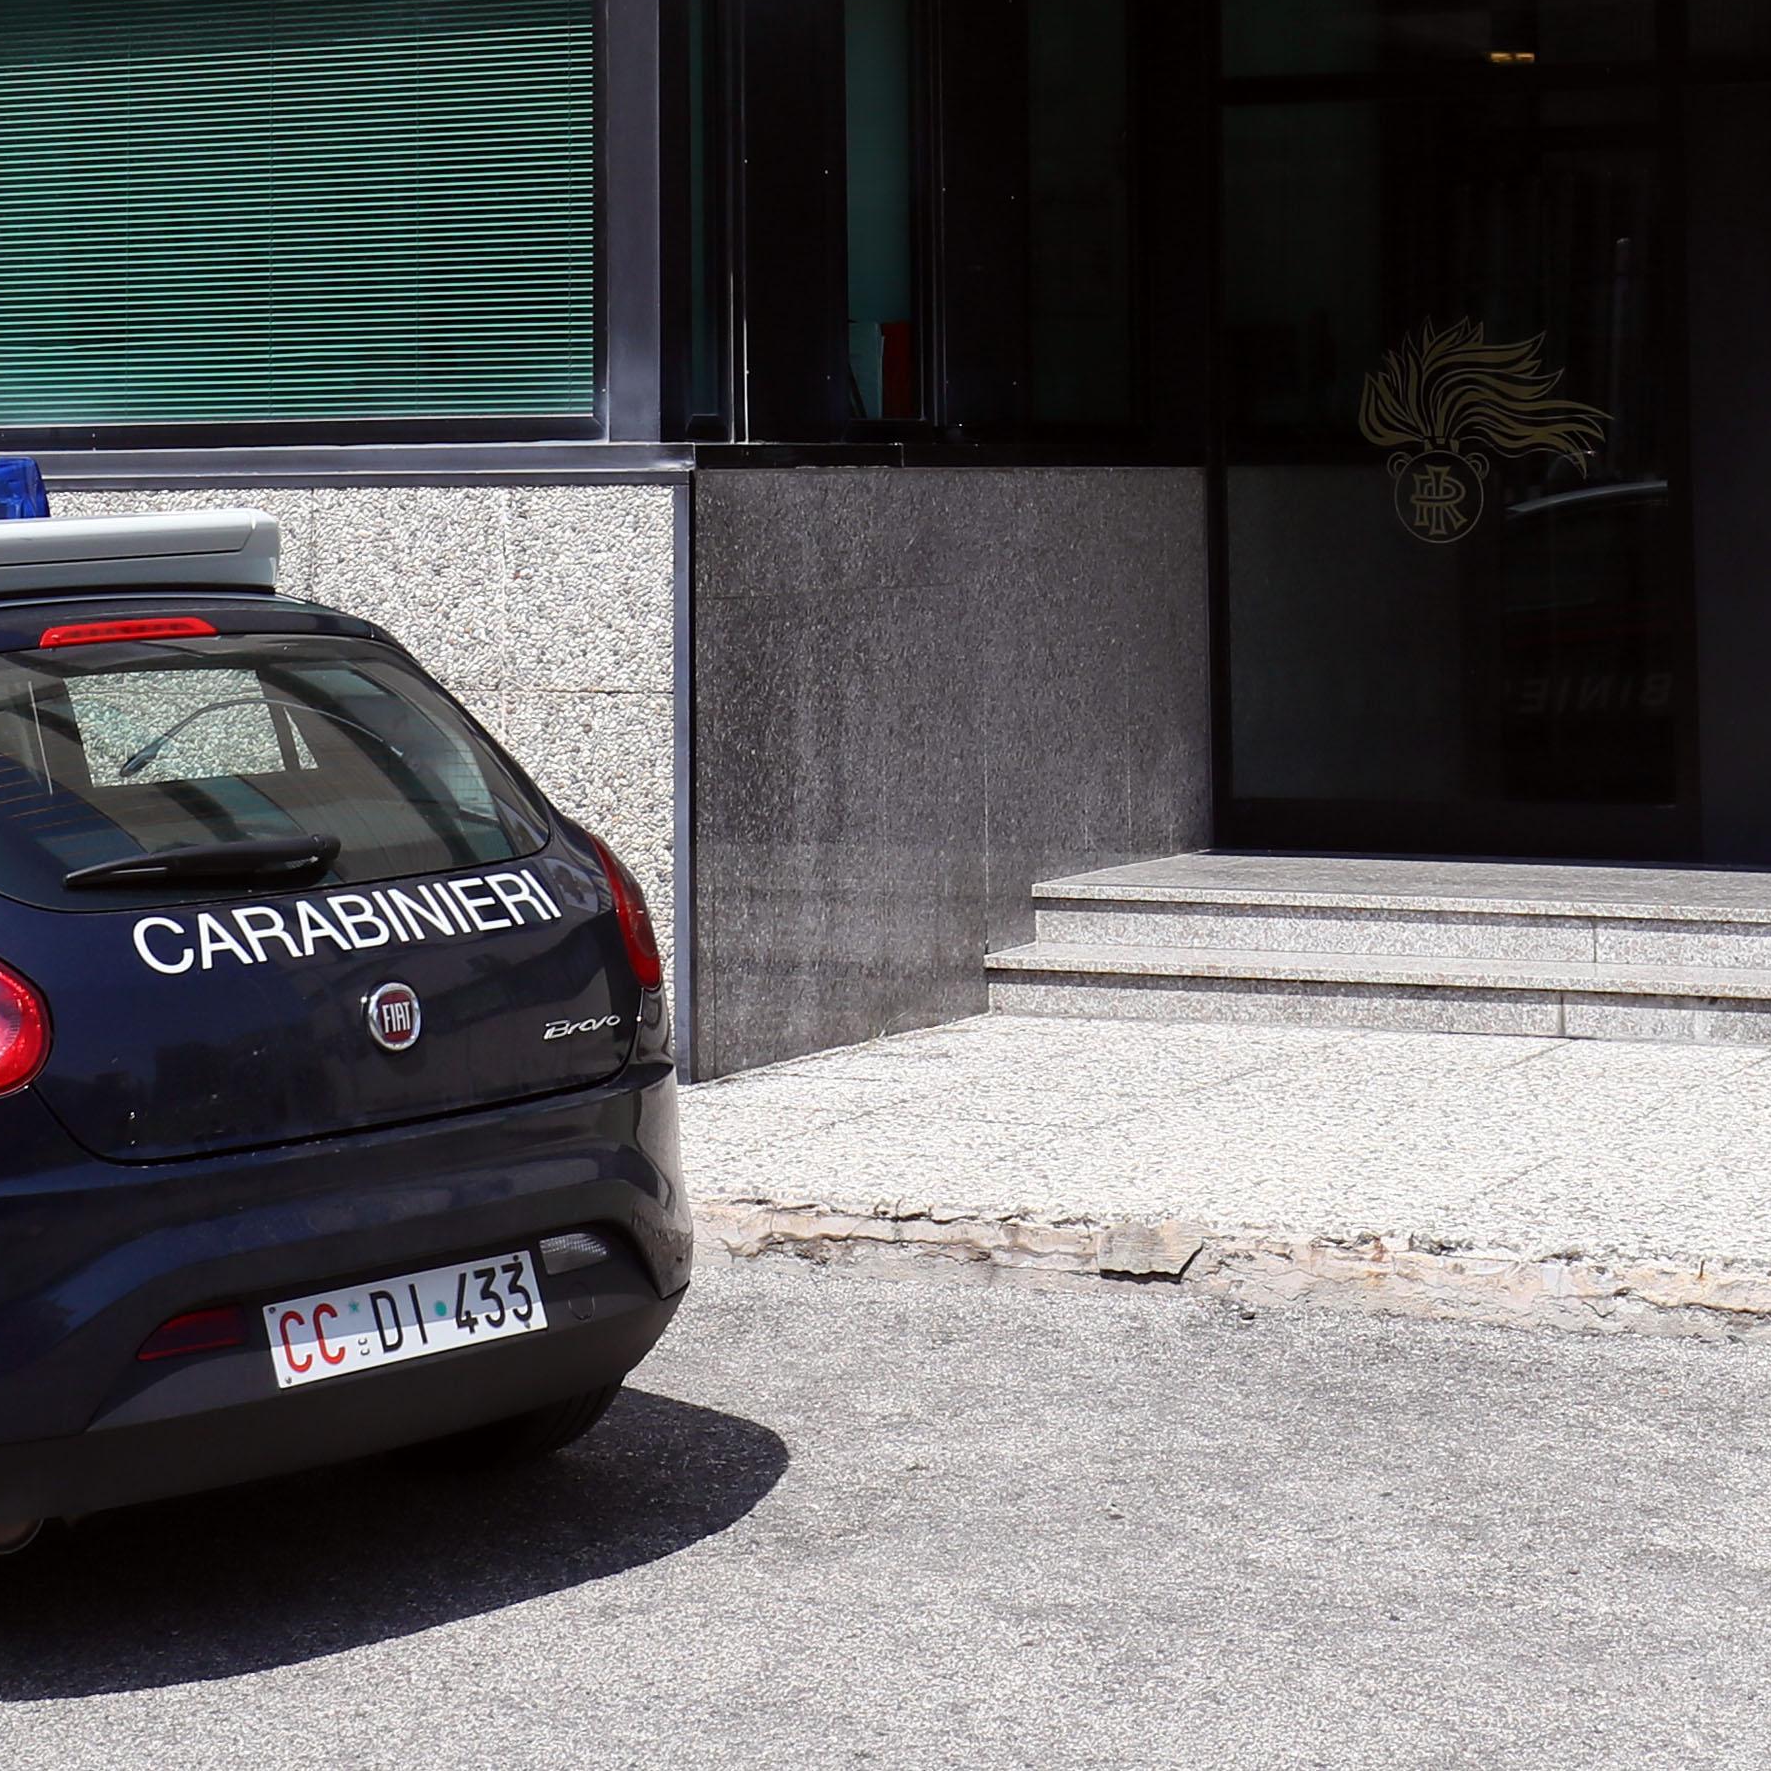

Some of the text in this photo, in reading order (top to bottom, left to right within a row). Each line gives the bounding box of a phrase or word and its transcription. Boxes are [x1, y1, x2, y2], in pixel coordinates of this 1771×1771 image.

[132, 869, 561, 976] CARABINIERI
[382, 1001, 412, 1033] FIAT
[544, 1015, 621, 1040] Bravo
[279, 1261, 534, 1373] CC DI 433
